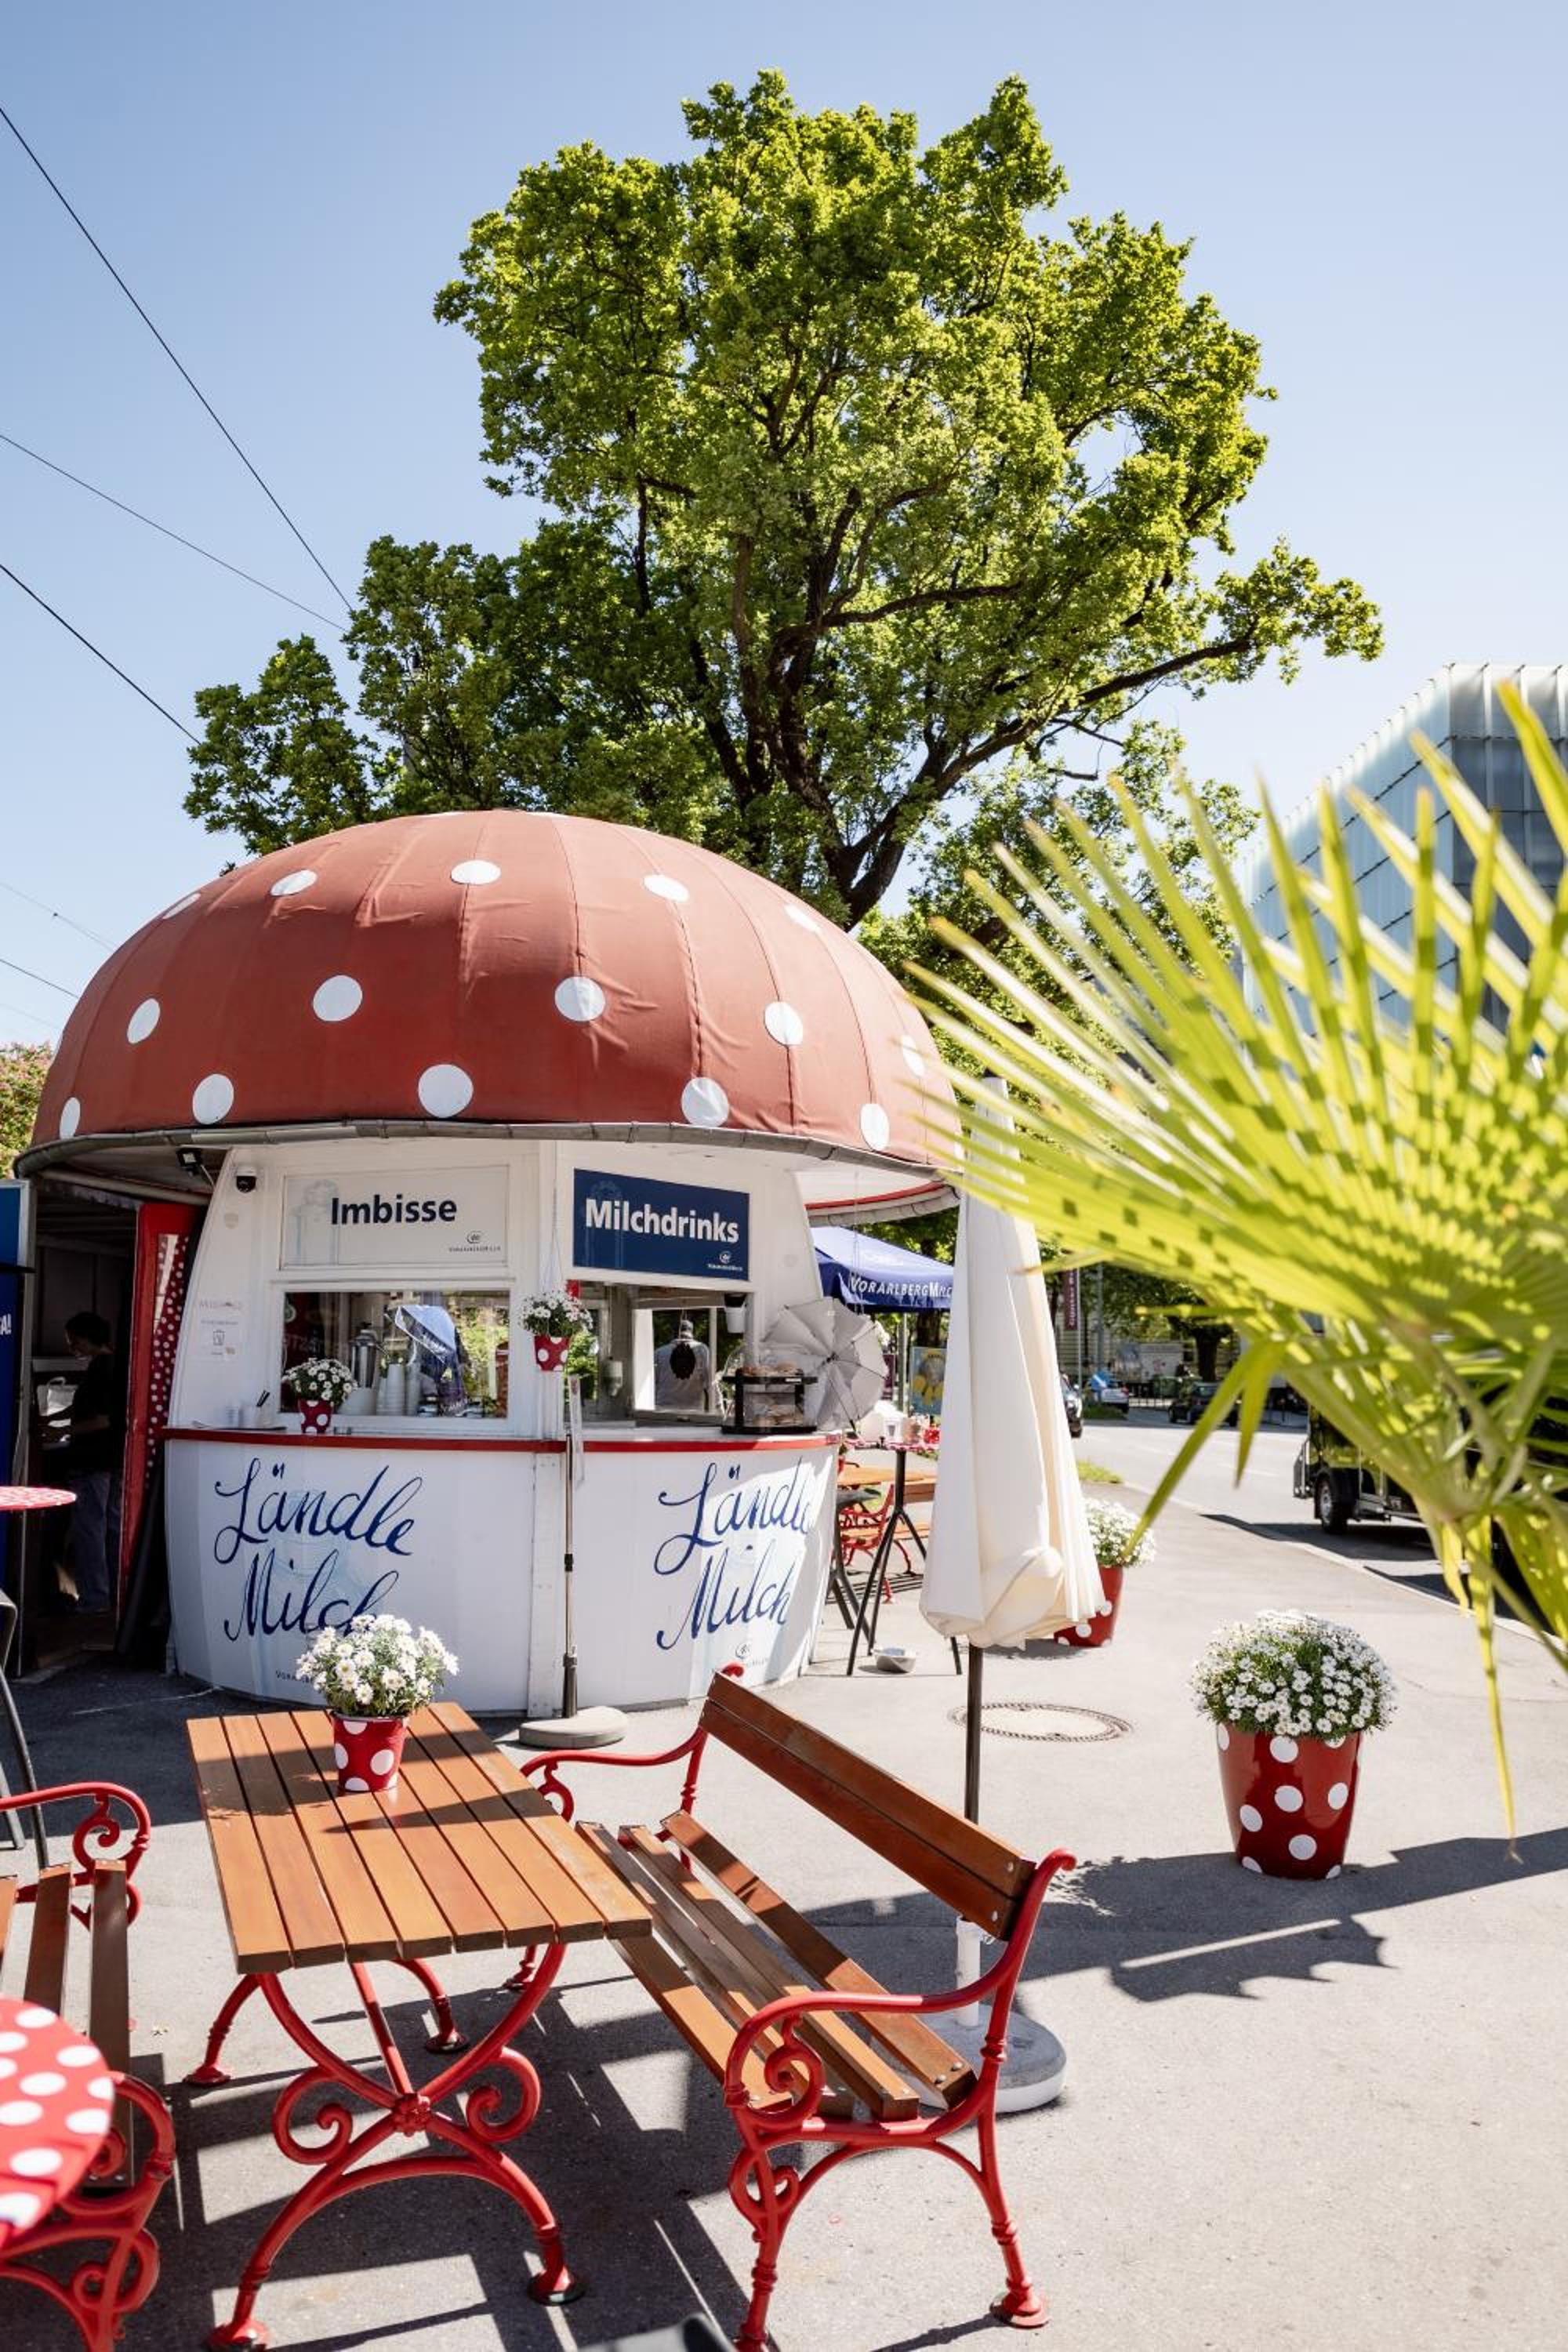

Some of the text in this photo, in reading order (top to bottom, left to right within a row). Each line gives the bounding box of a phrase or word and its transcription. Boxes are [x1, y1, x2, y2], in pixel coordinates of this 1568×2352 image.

[331, 1193, 457, 1225] Imbisse
[585, 1197, 740, 1243] Milchdrinks
[214, 1457, 423, 1564] Ländle
[656, 1538, 796, 1650] Milch
